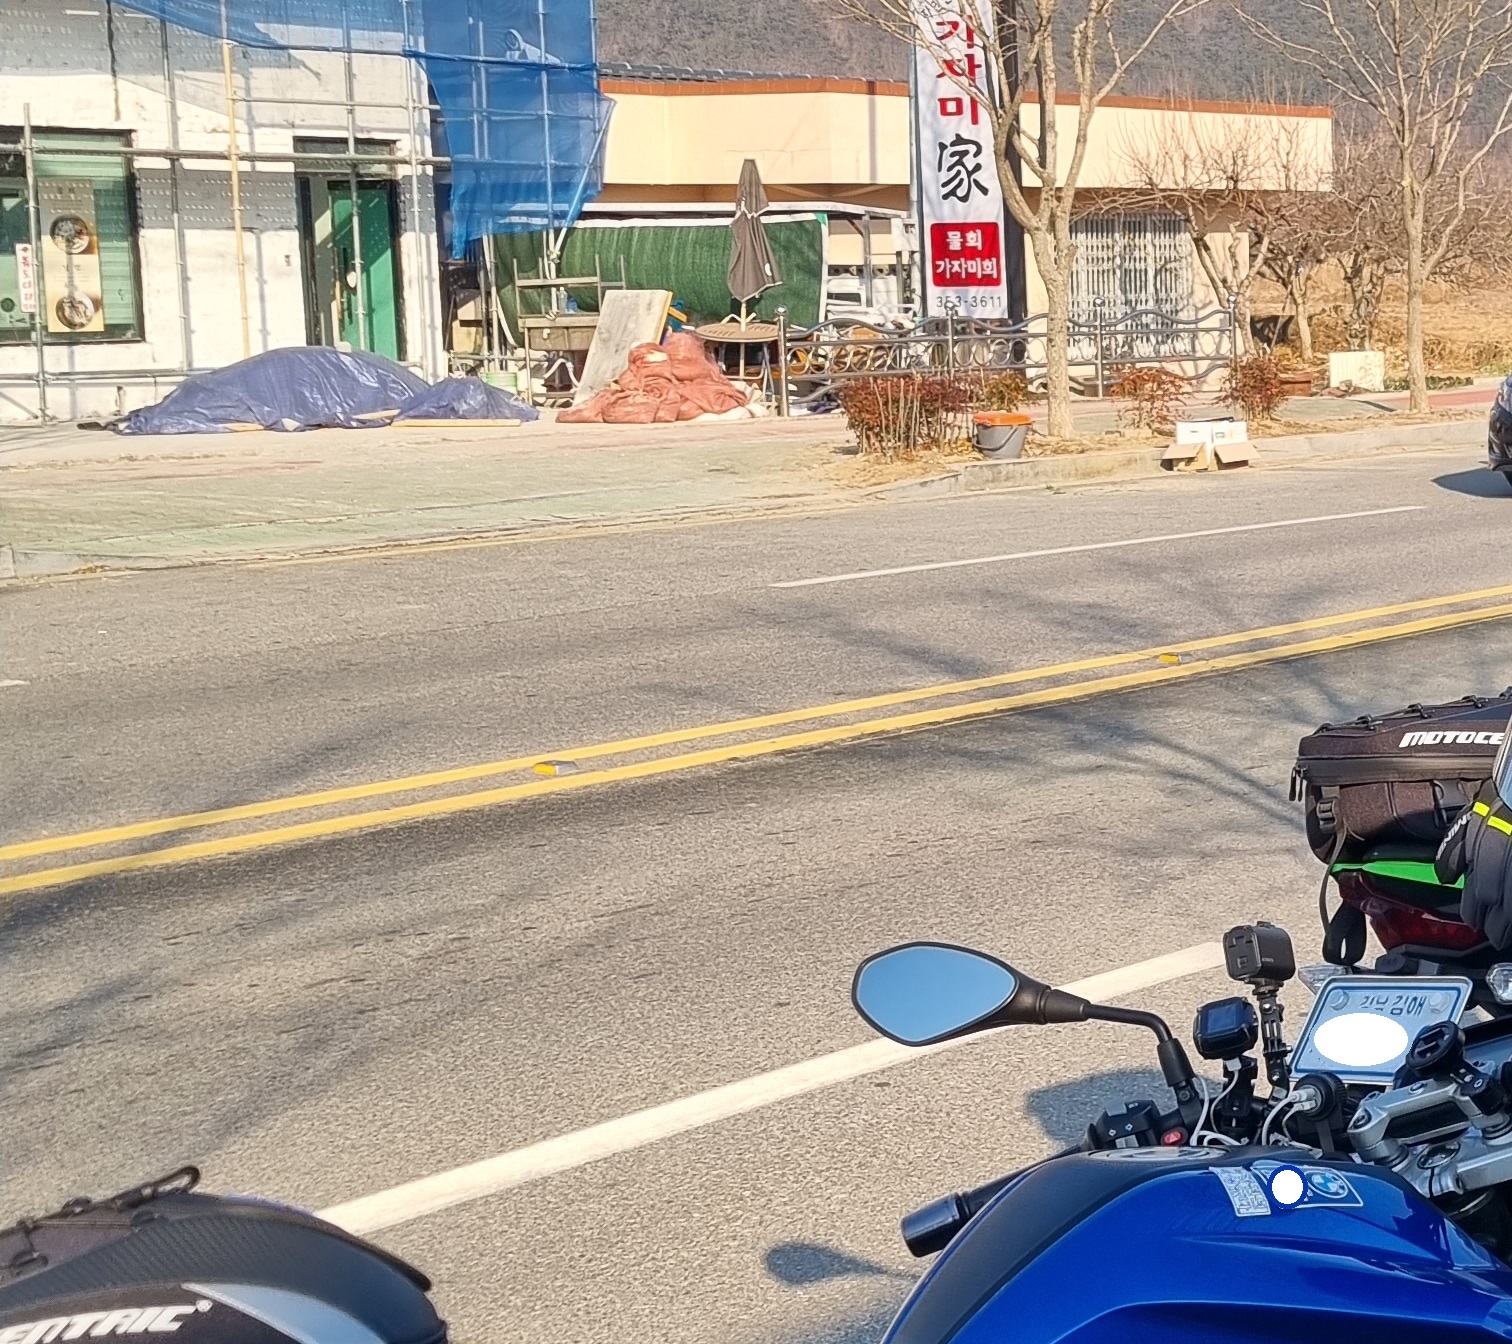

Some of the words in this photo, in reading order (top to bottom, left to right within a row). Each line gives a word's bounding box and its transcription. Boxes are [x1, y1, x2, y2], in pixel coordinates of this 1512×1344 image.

[946, 229, 983, 251] 물회
[936, 257, 998, 280] 가자미회
[936, 295, 1002, 308] 353-3611
[1399, 731, 1506, 748] MOTOCE
